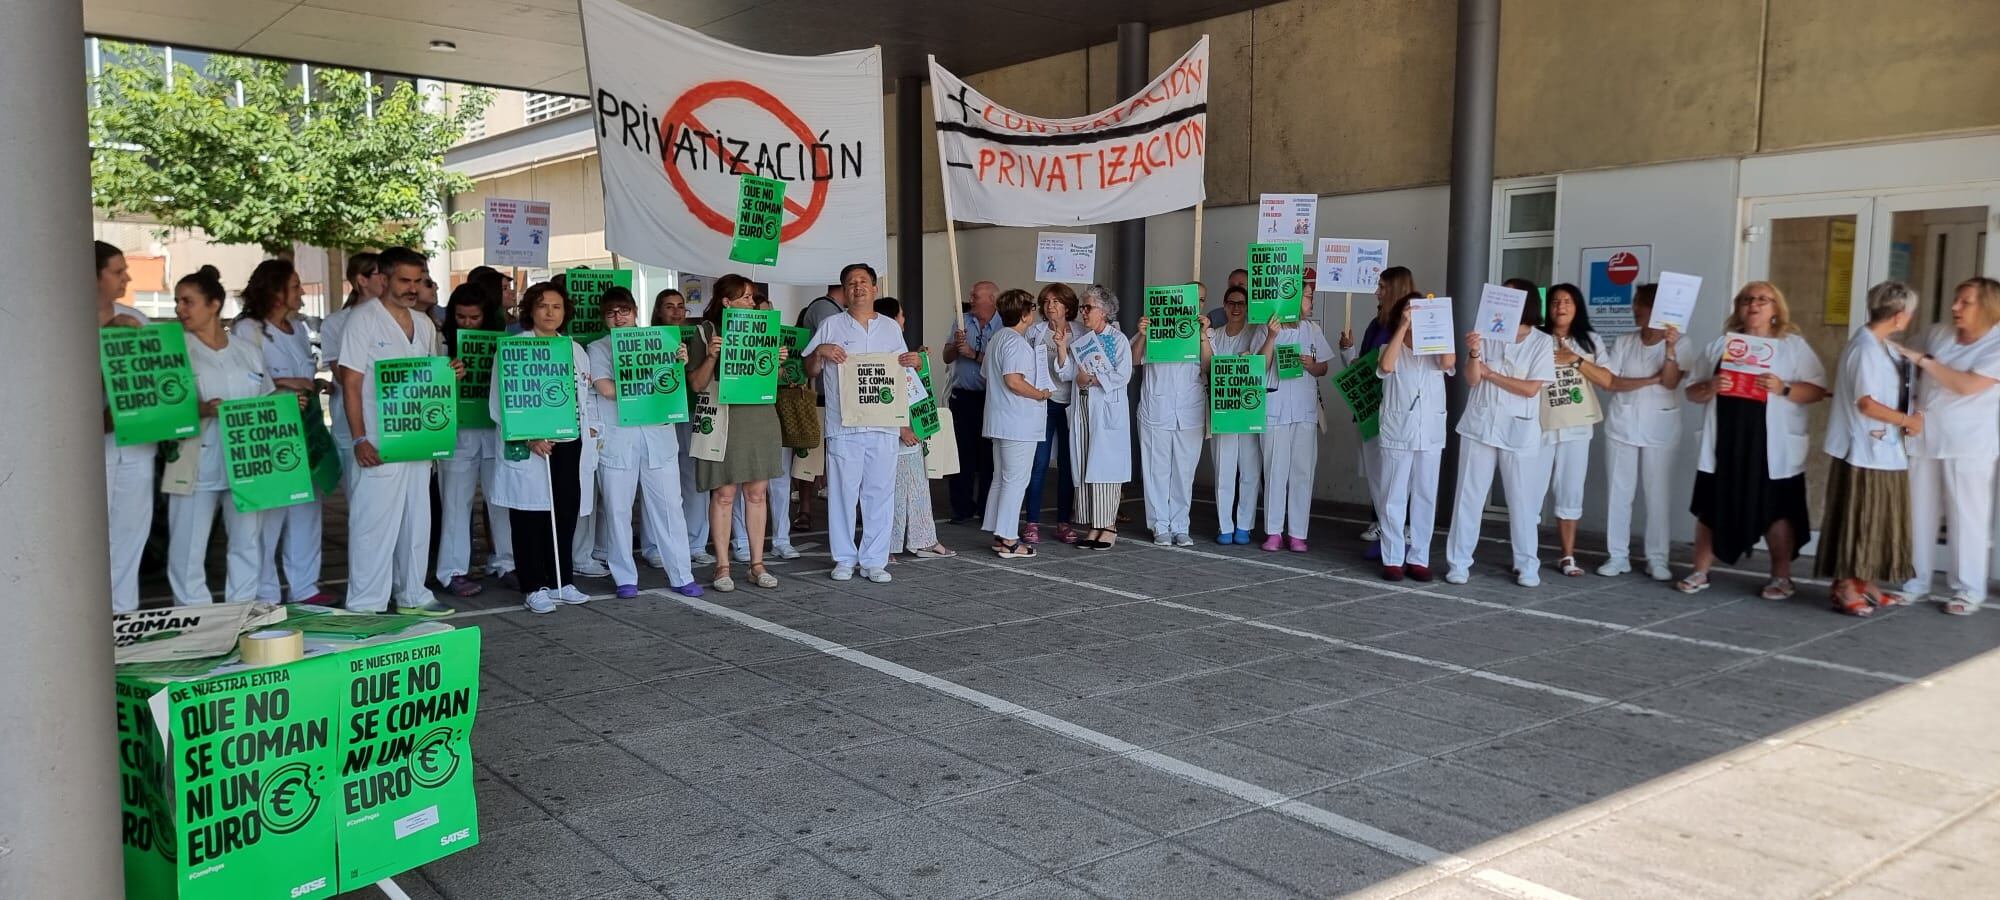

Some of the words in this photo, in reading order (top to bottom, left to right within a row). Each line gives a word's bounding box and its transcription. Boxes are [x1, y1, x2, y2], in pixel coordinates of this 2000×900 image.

[598, 87, 863, 181] PRIVATIZACIÓN
[978, 120, 1204, 192] PRIVATIZACIÓN
[744, 185, 760, 197] QUE
[763, 189, 773, 200] NO
[742, 199, 753, 210] SE
[755, 200, 781, 214] COMAN
[741, 211, 750, 223] NI
[752, 213, 764, 225] UN
[739, 225, 762, 238] EURO
[1252, 253, 1270, 264] QUE
[1274, 253, 1287, 263] NO
[1252, 266, 1262, 275] SE
[1266, 265, 1300, 275] COMAN
[572, 281, 594, 292] QUE
[1252, 277, 1262, 287] NI
[1265, 277, 1278, 287] UN
[1150, 296, 1168, 306] QUE
[1171, 295, 1183, 305] NO
[1252, 289, 1278, 300] EURO
[1150, 307, 1160, 317] SE
[1163, 305, 1196, 316] COMAN
[727, 320, 749, 333] QUE
[752, 321, 766, 333] NO
[1150, 318, 1159, 327] NI
[1163, 317, 1175, 327] UN
[726, 335, 738, 346] SE
[743, 335, 777, 347] COMAN
[1150, 329, 1176, 339] EURO
[104, 341, 136, 357] QUE
[138, 338, 162, 354] NO
[617, 338, 641, 352] QUE
[645, 338, 662, 351] NO
[502, 348, 525, 361] QUE
[532, 348, 551, 361] NO
[619, 354, 635, 367] SE
[725, 348, 737, 360] NI
[740, 348, 756, 361] UN
[109, 360, 128, 375] SE
[131, 353, 185, 373] COMAN
[503, 364, 518, 377] SE
[522, 363, 569, 376] COMAN
[724, 363, 755, 376] EURO
[1215, 364, 1233, 375] QUE
[1236, 364, 1249, 375] NO
[381, 370, 408, 384] QUE
[413, 369, 432, 382] NO
[620, 368, 632, 382] NI
[636, 367, 654, 380] UN
[858, 368, 872, 376] QUE
[875, 368, 885, 376] NO
[112, 377, 128, 393] NI
[133, 374, 156, 390] UN
[504, 379, 518, 392] NI
[522, 379, 541, 392] UN
[858, 378, 868, 386] SE
[869, 377, 894, 386] COMAN
[1215, 376, 1225, 386] SE
[1228, 375, 1262, 386] COMAN
[382, 386, 398, 400] SE
[403, 385, 451, 399] COMAN
[621, 383, 654, 397] EURO
[869, 386, 880, 394] UN
[1215, 388, 1224, 398] NI
[1227, 388, 1240, 398] UN
[115, 391, 158, 411] EURO
[505, 394, 542, 409] EURO
[859, 395, 880, 404] EURO
[1215, 400, 1240, 410] EURO
[383, 402, 397, 415] NI
[402, 401, 421, 415] UN
[226, 411, 255, 428] QUE
[257, 409, 277, 424] NO
[384, 418, 422, 432] EURO
[228, 429, 246, 445] SE
[248, 422, 299, 442] COMAN
[230, 446, 246, 461] NI
[250, 443, 270, 459] UN
[233, 460, 272, 479] EURO
[116, 616, 200, 633] COMAN
[350, 659, 364, 673] DE
[366, 649, 409, 670] NUESTRA
[412, 644, 441, 661] EXTRA
[170, 688, 191, 703] DE
[191, 676, 248, 696] NUESTRA
[251, 669, 290, 687] EXTRA
[351, 669, 400, 708] QUE
[408, 661, 441, 696] NO
[181, 697, 235, 741] QUE
[245, 688, 289, 726] NO
[350, 709, 379, 744] SE
[386, 687, 470, 733] COMAN
[185, 742, 213, 783] SE
[221, 717, 328, 769] COMAN
[342, 744, 374, 777] NI
[376, 733, 415, 767] UN
[186, 782, 213, 824] NI
[220, 769, 261, 811] UN
[343, 766, 412, 815] EURO
[188, 810, 262, 867] EURO
[440, 827, 470, 846] SATSE
[290, 877, 327, 898] SATSE
